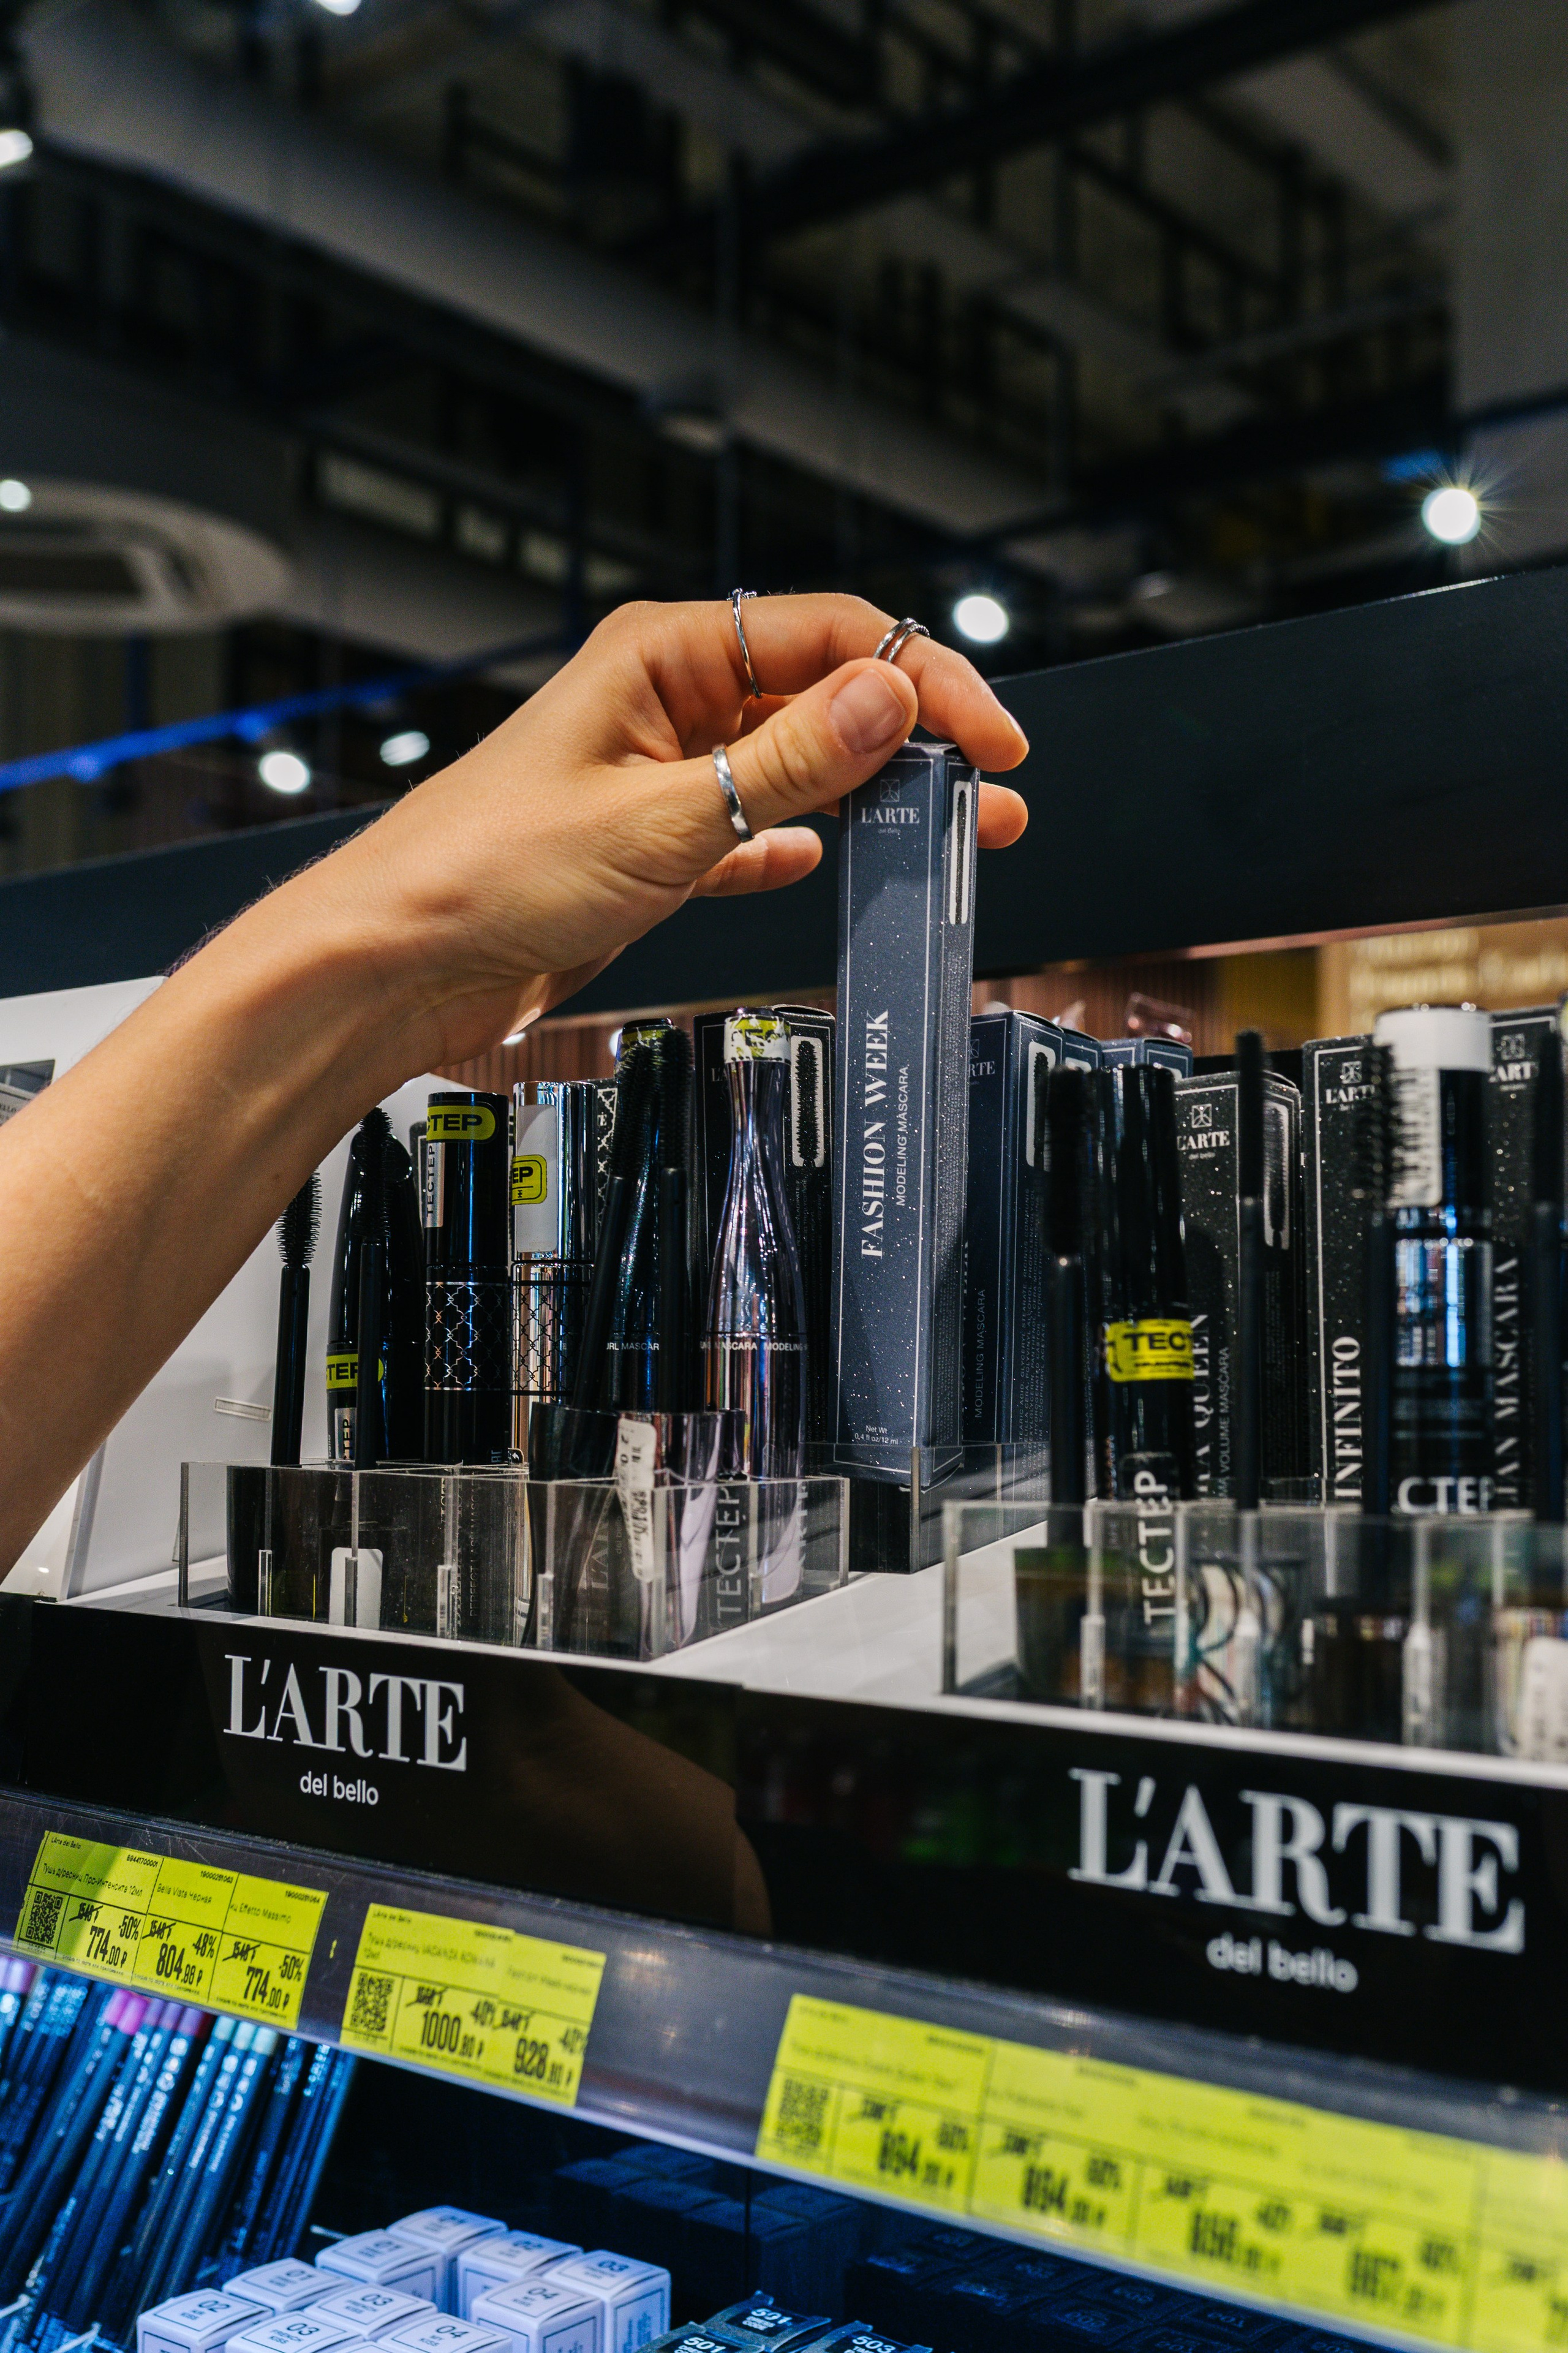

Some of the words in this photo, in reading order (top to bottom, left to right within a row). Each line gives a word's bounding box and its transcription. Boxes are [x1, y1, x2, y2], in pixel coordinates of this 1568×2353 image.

[865, 1009, 889, 1106] WEEK
[897, 1067, 909, 1131] MASCARA
[895, 1136, 907, 1206] MODELING
[861, 1119, 886, 1259] FASHION
[976, 1288, 986, 1348] MASCARA
[622, 1342, 660, 1351] MASCAR
[1493, 1257, 1521, 1421] MASCARA
[974, 1353, 984, 1418] MODELING
[1218, 1347, 1230, 1413] MASCARA
[1333, 1335, 1363, 1499] INFINITO
[1219, 1416, 1231, 1473] VOLUME
[469, 1565, 479, 1617] PERFECT
[223, 1654, 467, 1772] L'ARTE
[300, 1771, 328, 1797] del
[333, 1775, 379, 1806] bello
[43, 1863, 56, 1875] Тушь
[1067, 1767, 1525, 1955] L'ARTE
[157, 1883, 172, 1894] Bella
[119, 1915, 141, 1941] -50%
[192, 1933, 217, 1958] -48%
[279, 1954, 305, 1982] -50%
[1206, 1932, 1262, 1976] del
[1267, 1939, 1359, 1993] bello
[197, 2300, 230, 2313] 02
[361, 2293, 393, 2307] 03
[527, 2286, 560, 2300] 04
[287, 2322, 320, 2336] 03
[435, 2325, 470, 2338] 04
[750, 2307, 793, 2325] 501
[683, 2336, 726, 2353] 501
[851, 2335, 896, 2353] 503
